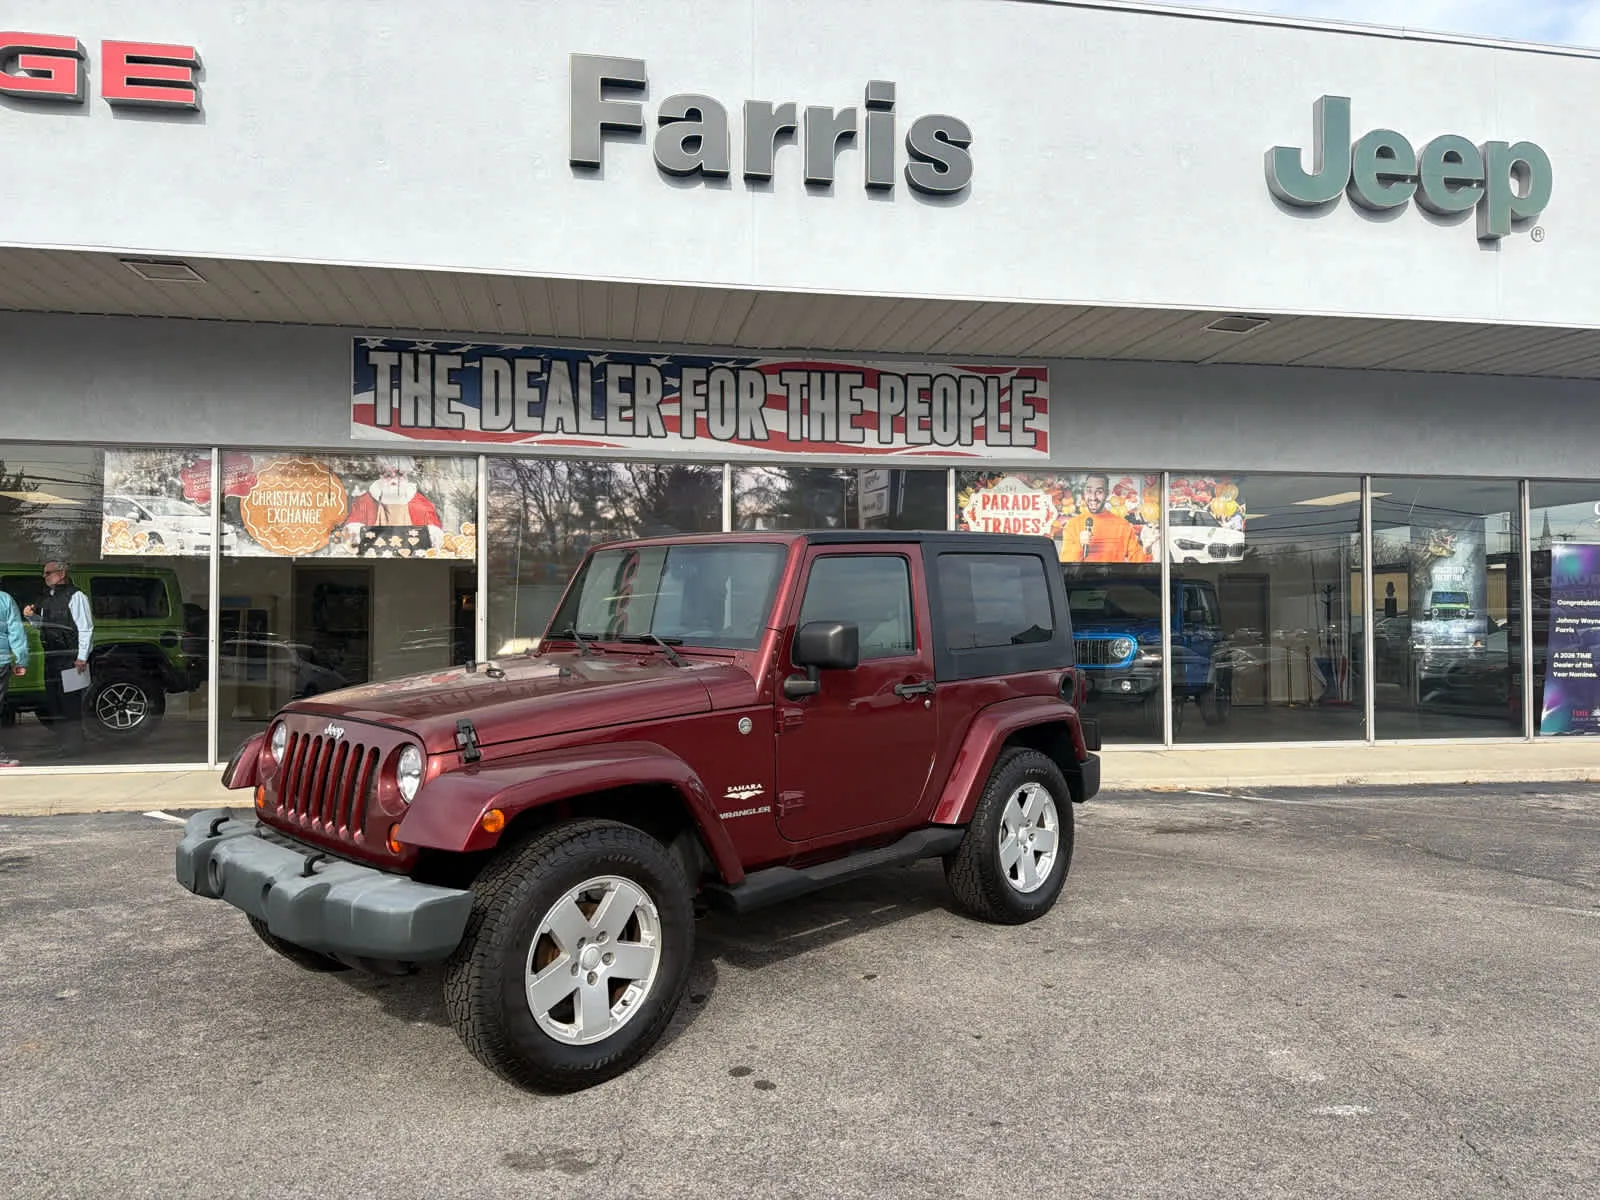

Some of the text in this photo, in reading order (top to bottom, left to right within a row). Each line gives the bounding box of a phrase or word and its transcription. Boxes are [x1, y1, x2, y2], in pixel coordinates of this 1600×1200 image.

[568, 53, 973, 195] Farris
[1264, 95, 1552, 240] Jeep
[368, 351, 1037, 447] THE DEALER FOR THE PEOPLE
[252, 490, 338, 508] CHRISTMAS CAR
[981, 494, 1041, 511] PARADE
[267, 508, 322, 525] EXCHANGE
[981, 517, 1041, 534] TRADES
[324, 722, 344, 739] Jeep
[727, 784, 762, 792] SAHARA
[720, 806, 771, 819] WRANGLER
